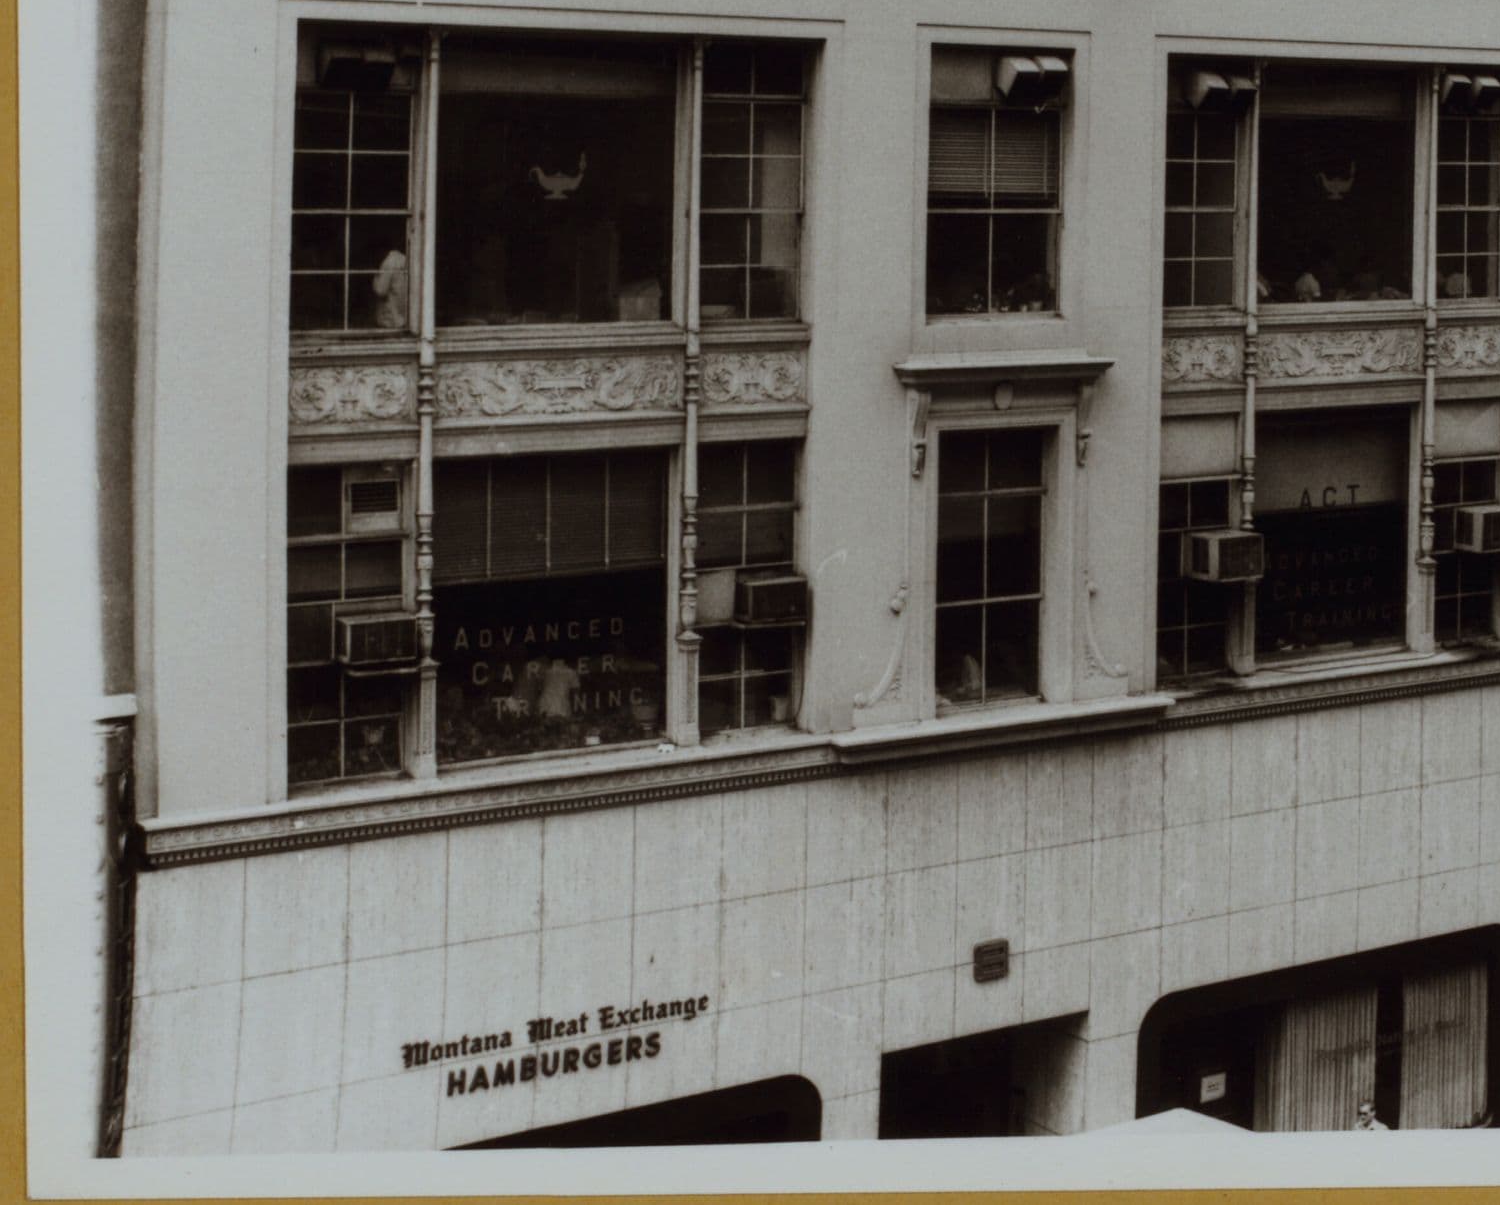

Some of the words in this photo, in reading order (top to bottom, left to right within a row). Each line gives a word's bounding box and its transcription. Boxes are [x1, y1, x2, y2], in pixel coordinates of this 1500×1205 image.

[1299, 484, 1361, 512] ACT
[454, 617, 624, 651] ADVANCED
[401, 1030, 512, 1069] Montana
[526, 1012, 589, 1043] Meat
[597, 994, 710, 1030] Exchange
[446, 1031, 662, 1097] HAMBURGERS
